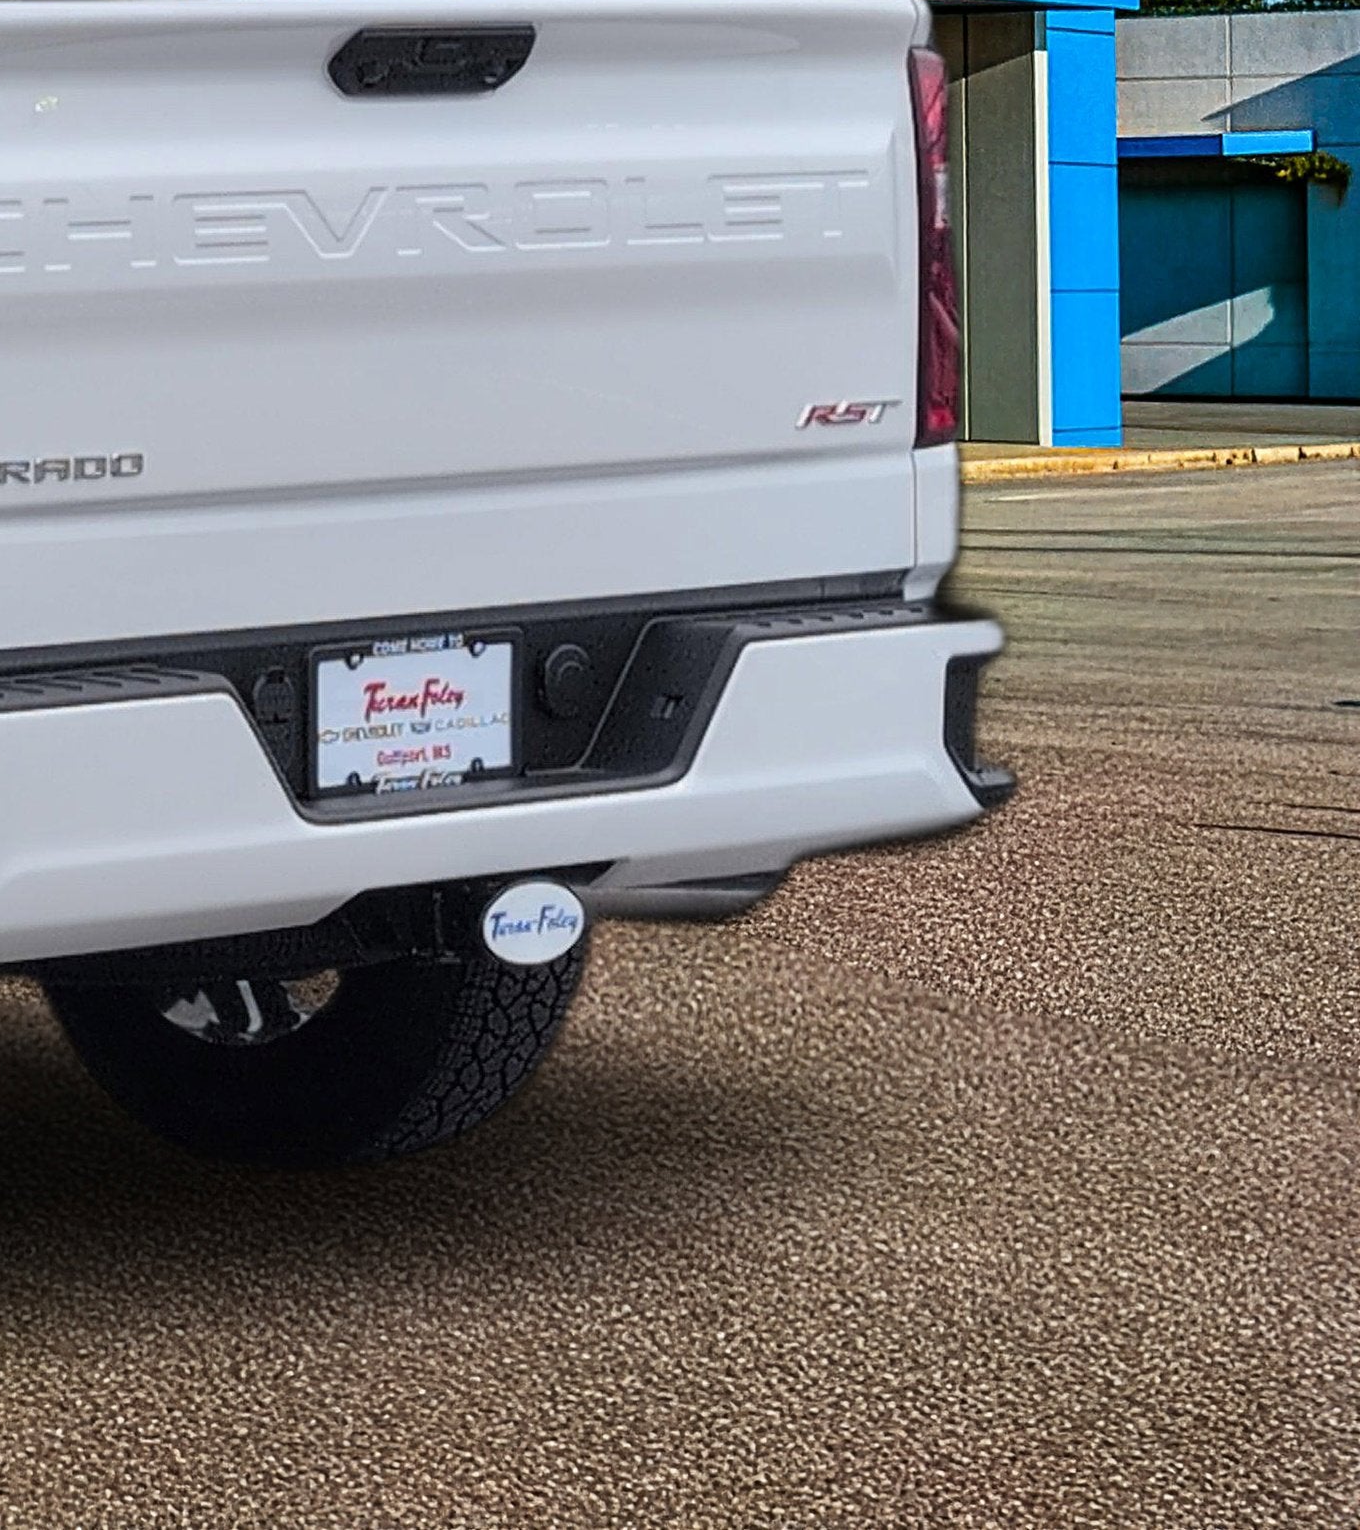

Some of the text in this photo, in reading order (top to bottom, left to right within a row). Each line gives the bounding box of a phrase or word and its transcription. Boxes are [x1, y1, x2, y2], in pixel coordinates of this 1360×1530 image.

[795, 398, 902, 429] RST
[364, 678, 464, 722] Turan Foley
[435, 713, 508, 730] CADILLAC
